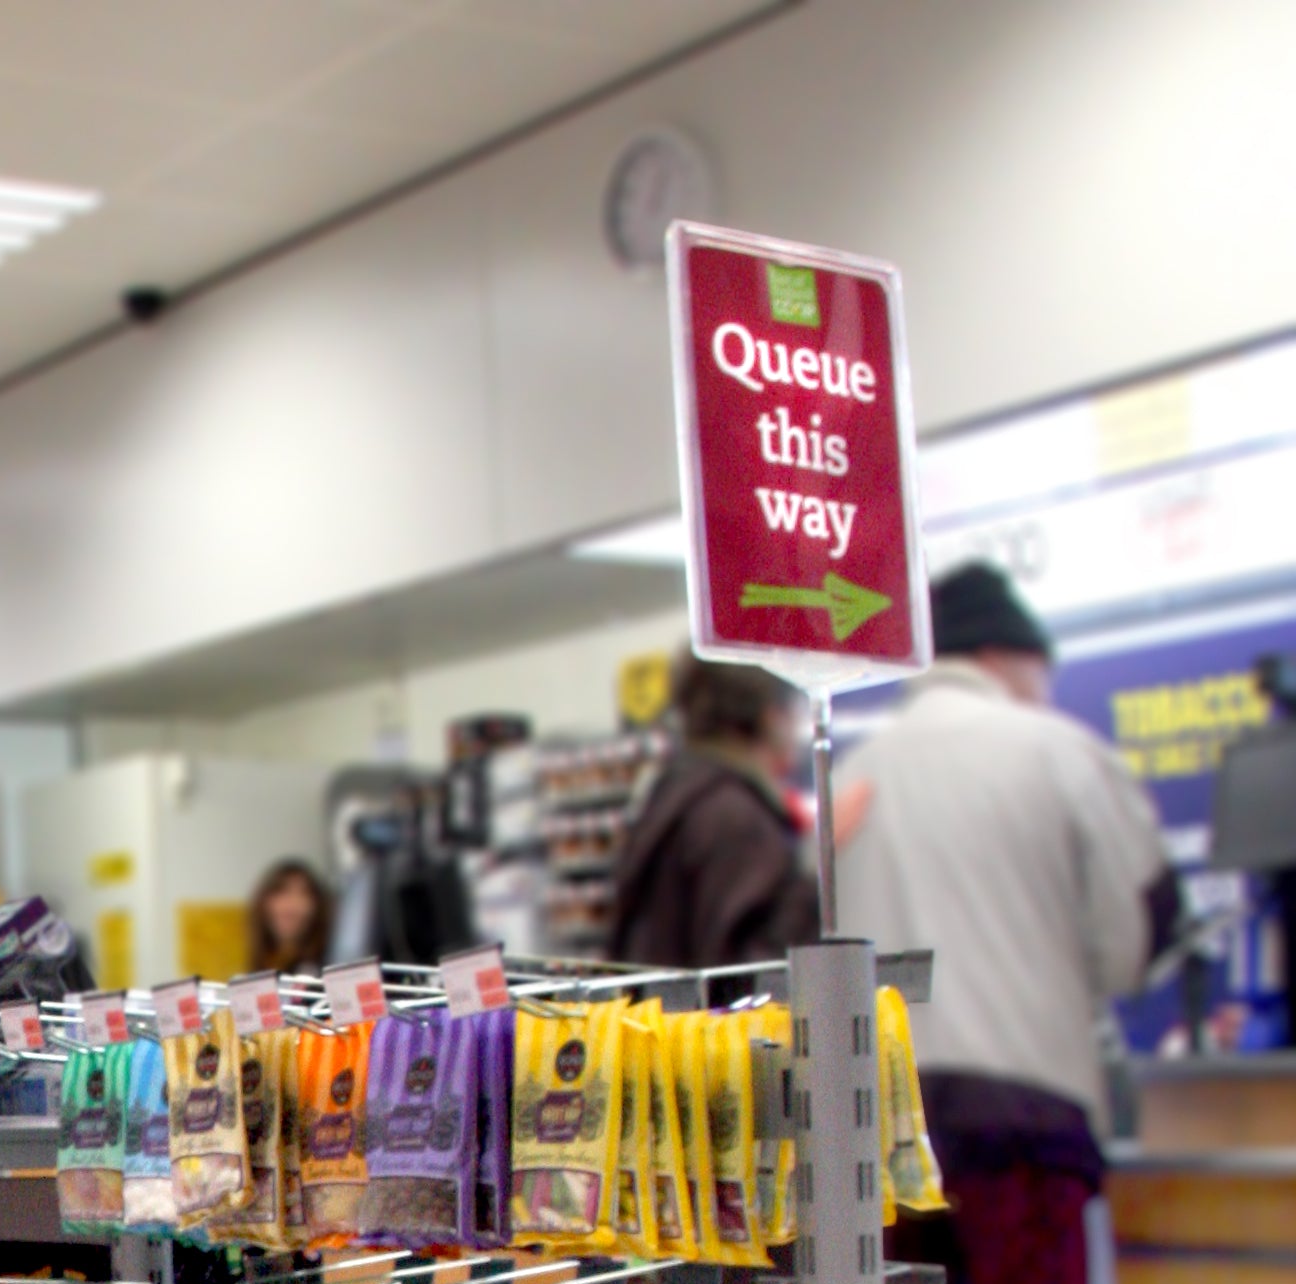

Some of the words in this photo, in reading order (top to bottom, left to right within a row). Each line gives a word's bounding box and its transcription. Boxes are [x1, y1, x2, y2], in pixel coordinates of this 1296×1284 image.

[712, 323, 875, 402] Queue
[756, 407, 849, 476] this
[755, 488, 856, 558] way
